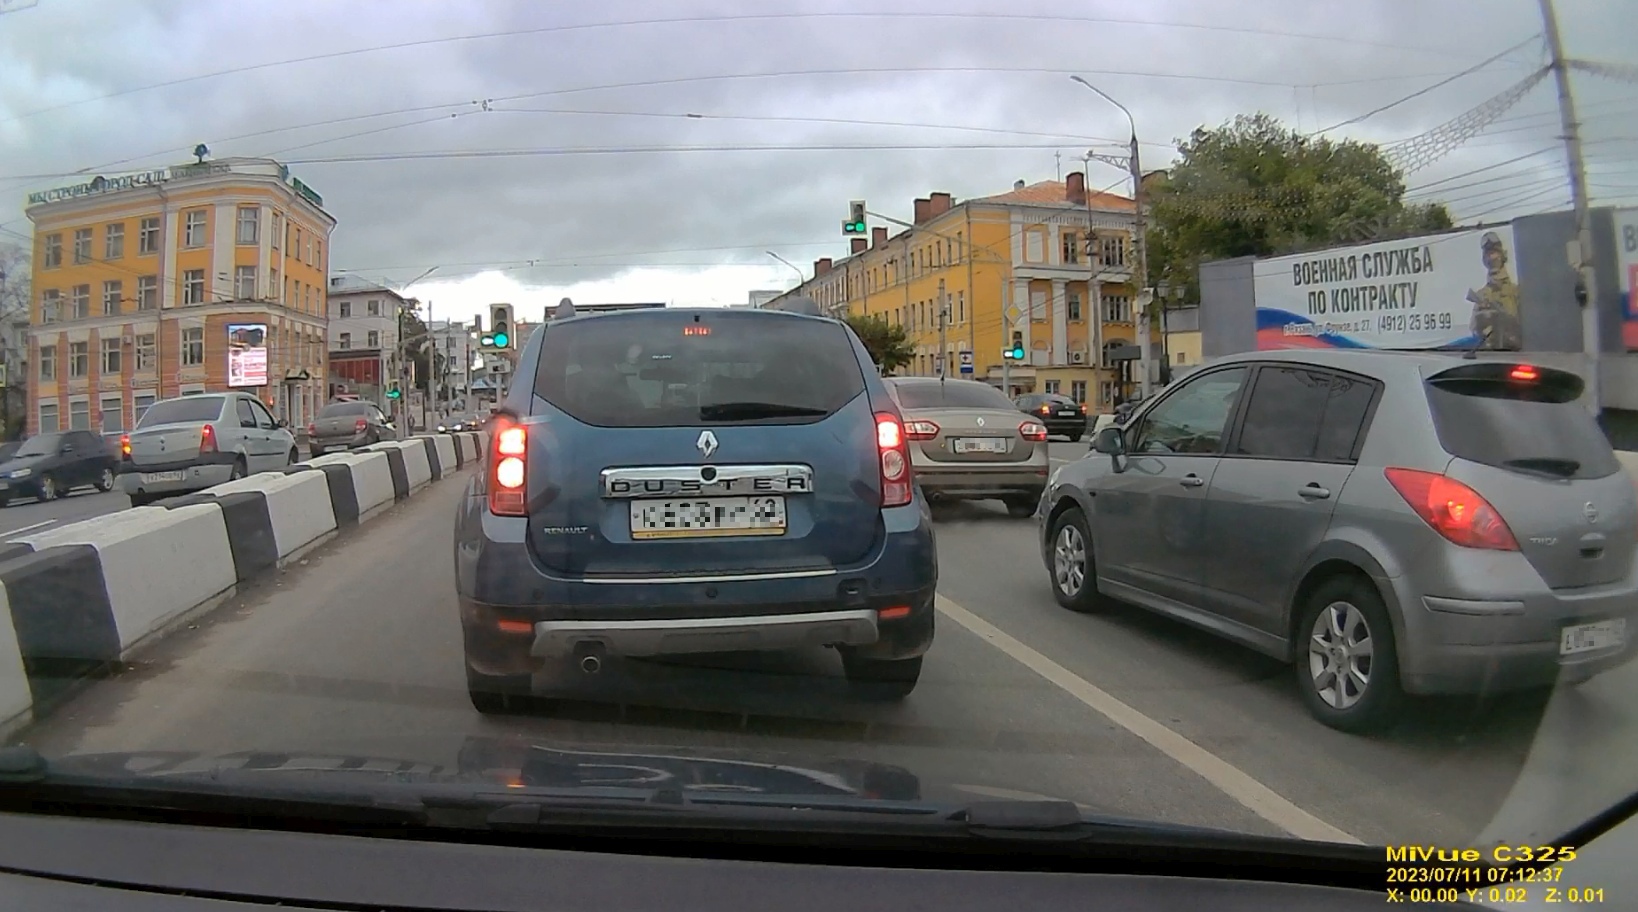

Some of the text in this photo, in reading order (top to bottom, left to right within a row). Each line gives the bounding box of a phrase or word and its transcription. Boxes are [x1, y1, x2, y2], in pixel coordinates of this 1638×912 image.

[1293, 246, 1433, 286] ВОЕННАЯ СЛУЖБА
[1308, 282, 1418, 314] ПО КОНТРАКТУ
[1378, 315, 1406, 334] (4912)
[1409, 314, 1421, 331] 25
[1424, 313, 1436, 330] 96
[1439, 312, 1452, 330] 99
[611, 477, 806, 493] DUSTER
[544, 526, 588, 535] RENAULT
